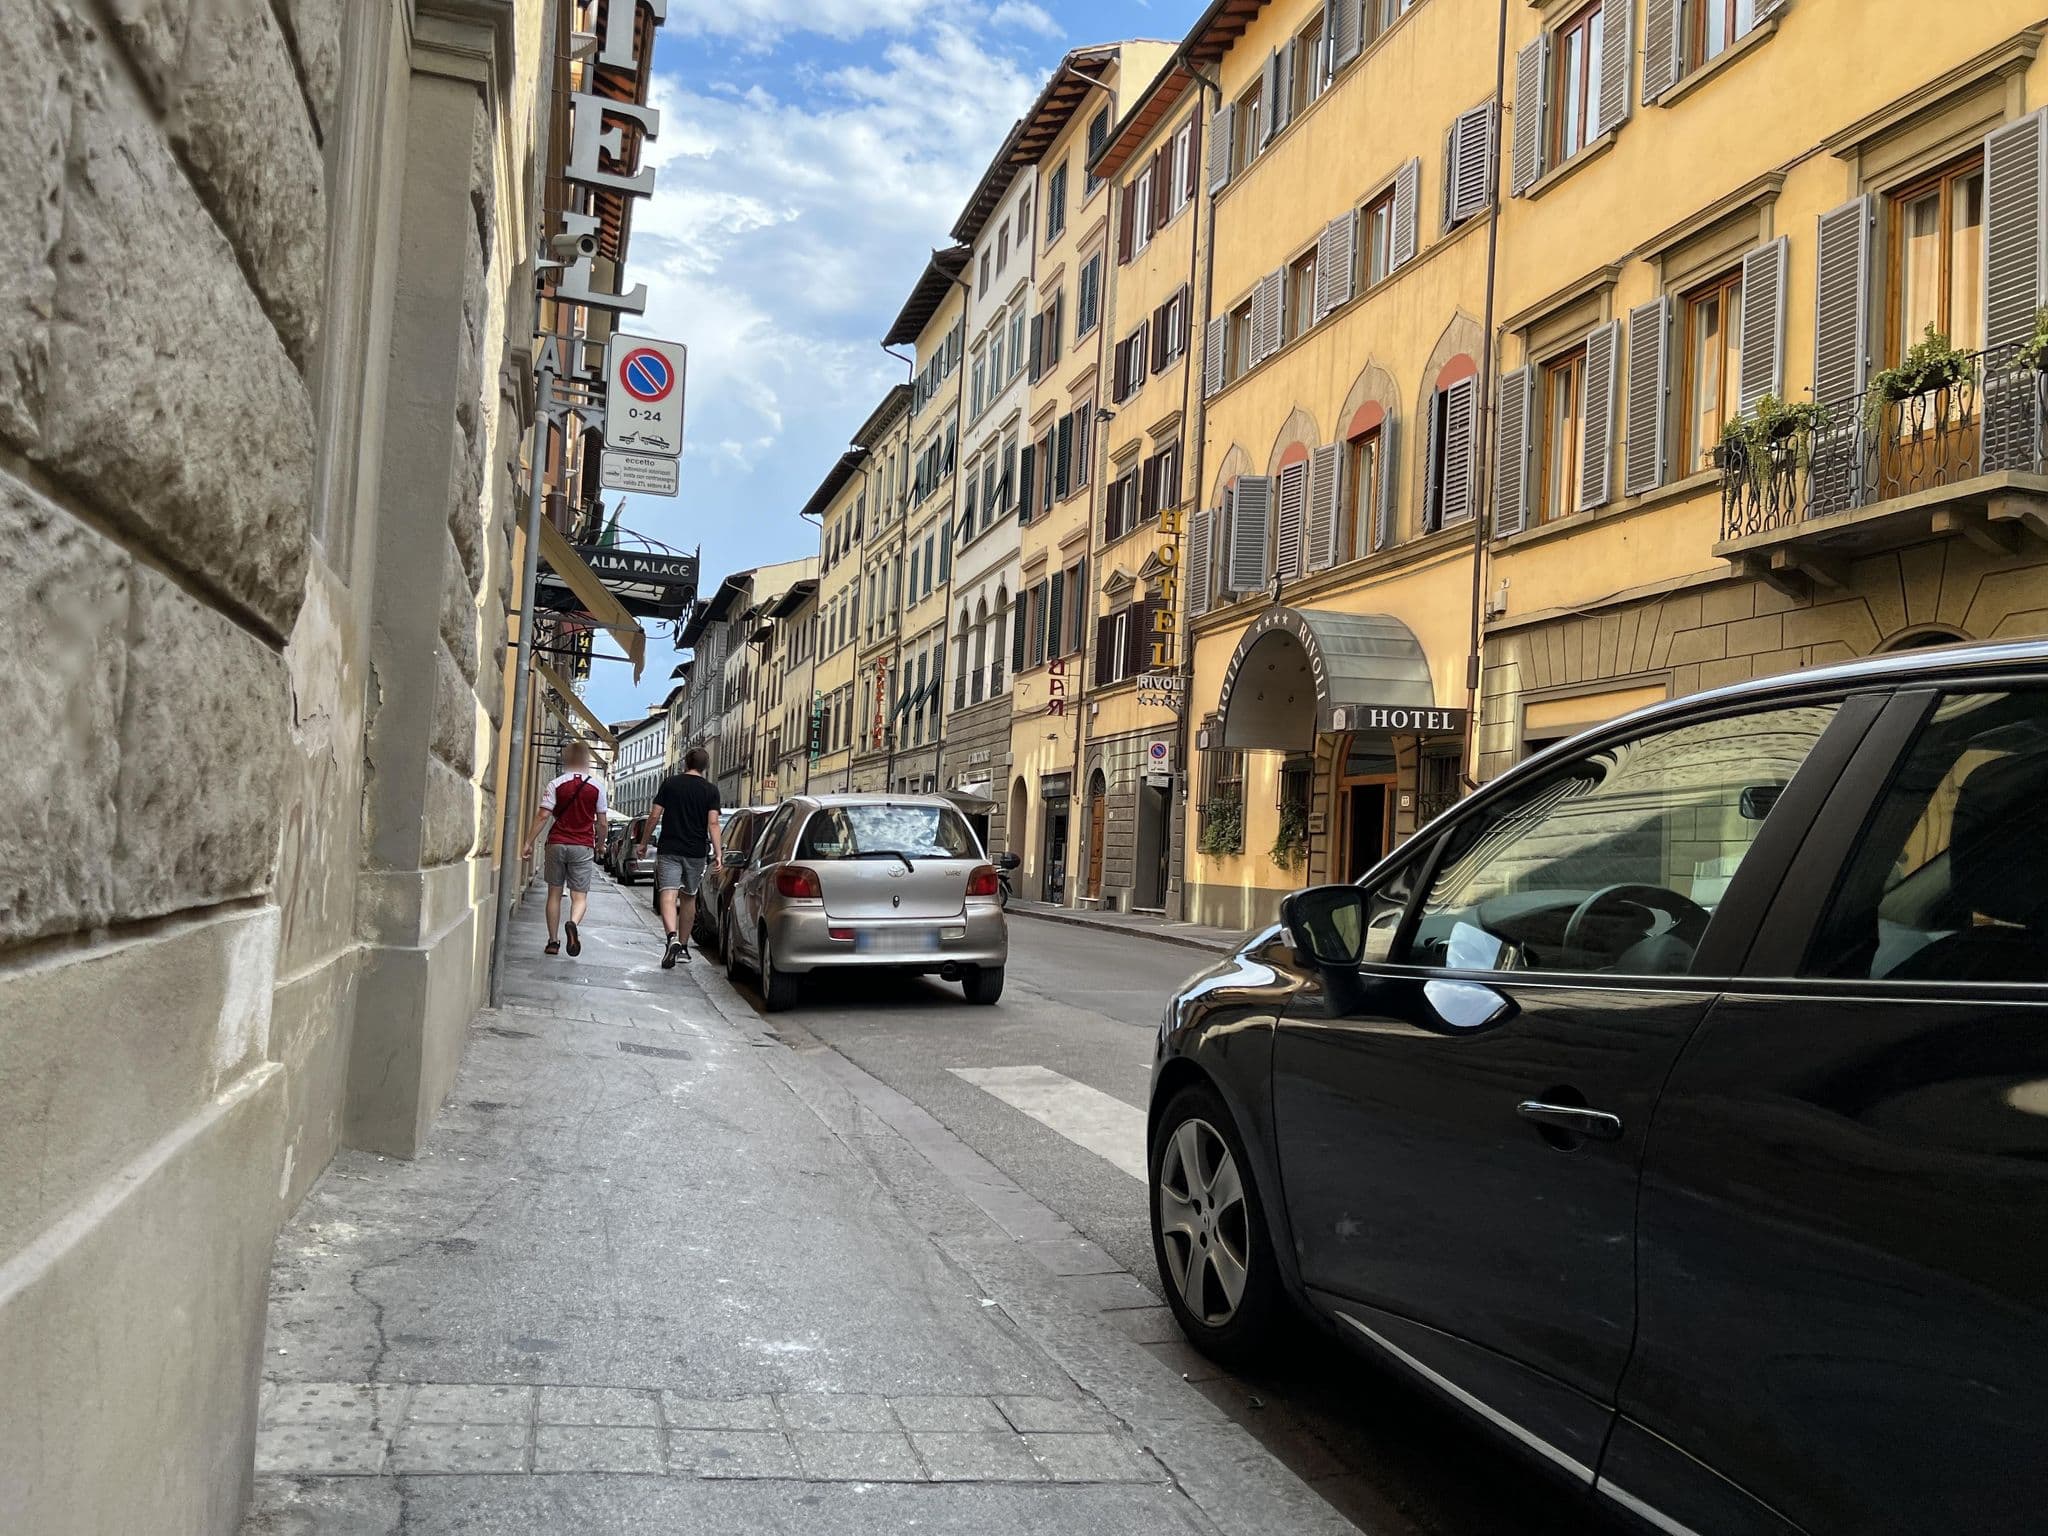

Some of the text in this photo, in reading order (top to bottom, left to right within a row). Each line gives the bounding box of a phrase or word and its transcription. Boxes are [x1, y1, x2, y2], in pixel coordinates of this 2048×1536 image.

[534, 335, 608, 382] AL
[629, 408, 662, 422] 0-24
[625, 457, 655, 467] eccetto
[589, 555, 690, 577] ALBA PALACE
[1152, 508, 1182, 667] HOTEL
[1299, 621, 1327, 701] RIVOLI
[1140, 676, 1184, 690] RIVOLI
[1370, 709, 1455, 730] HOTEL
